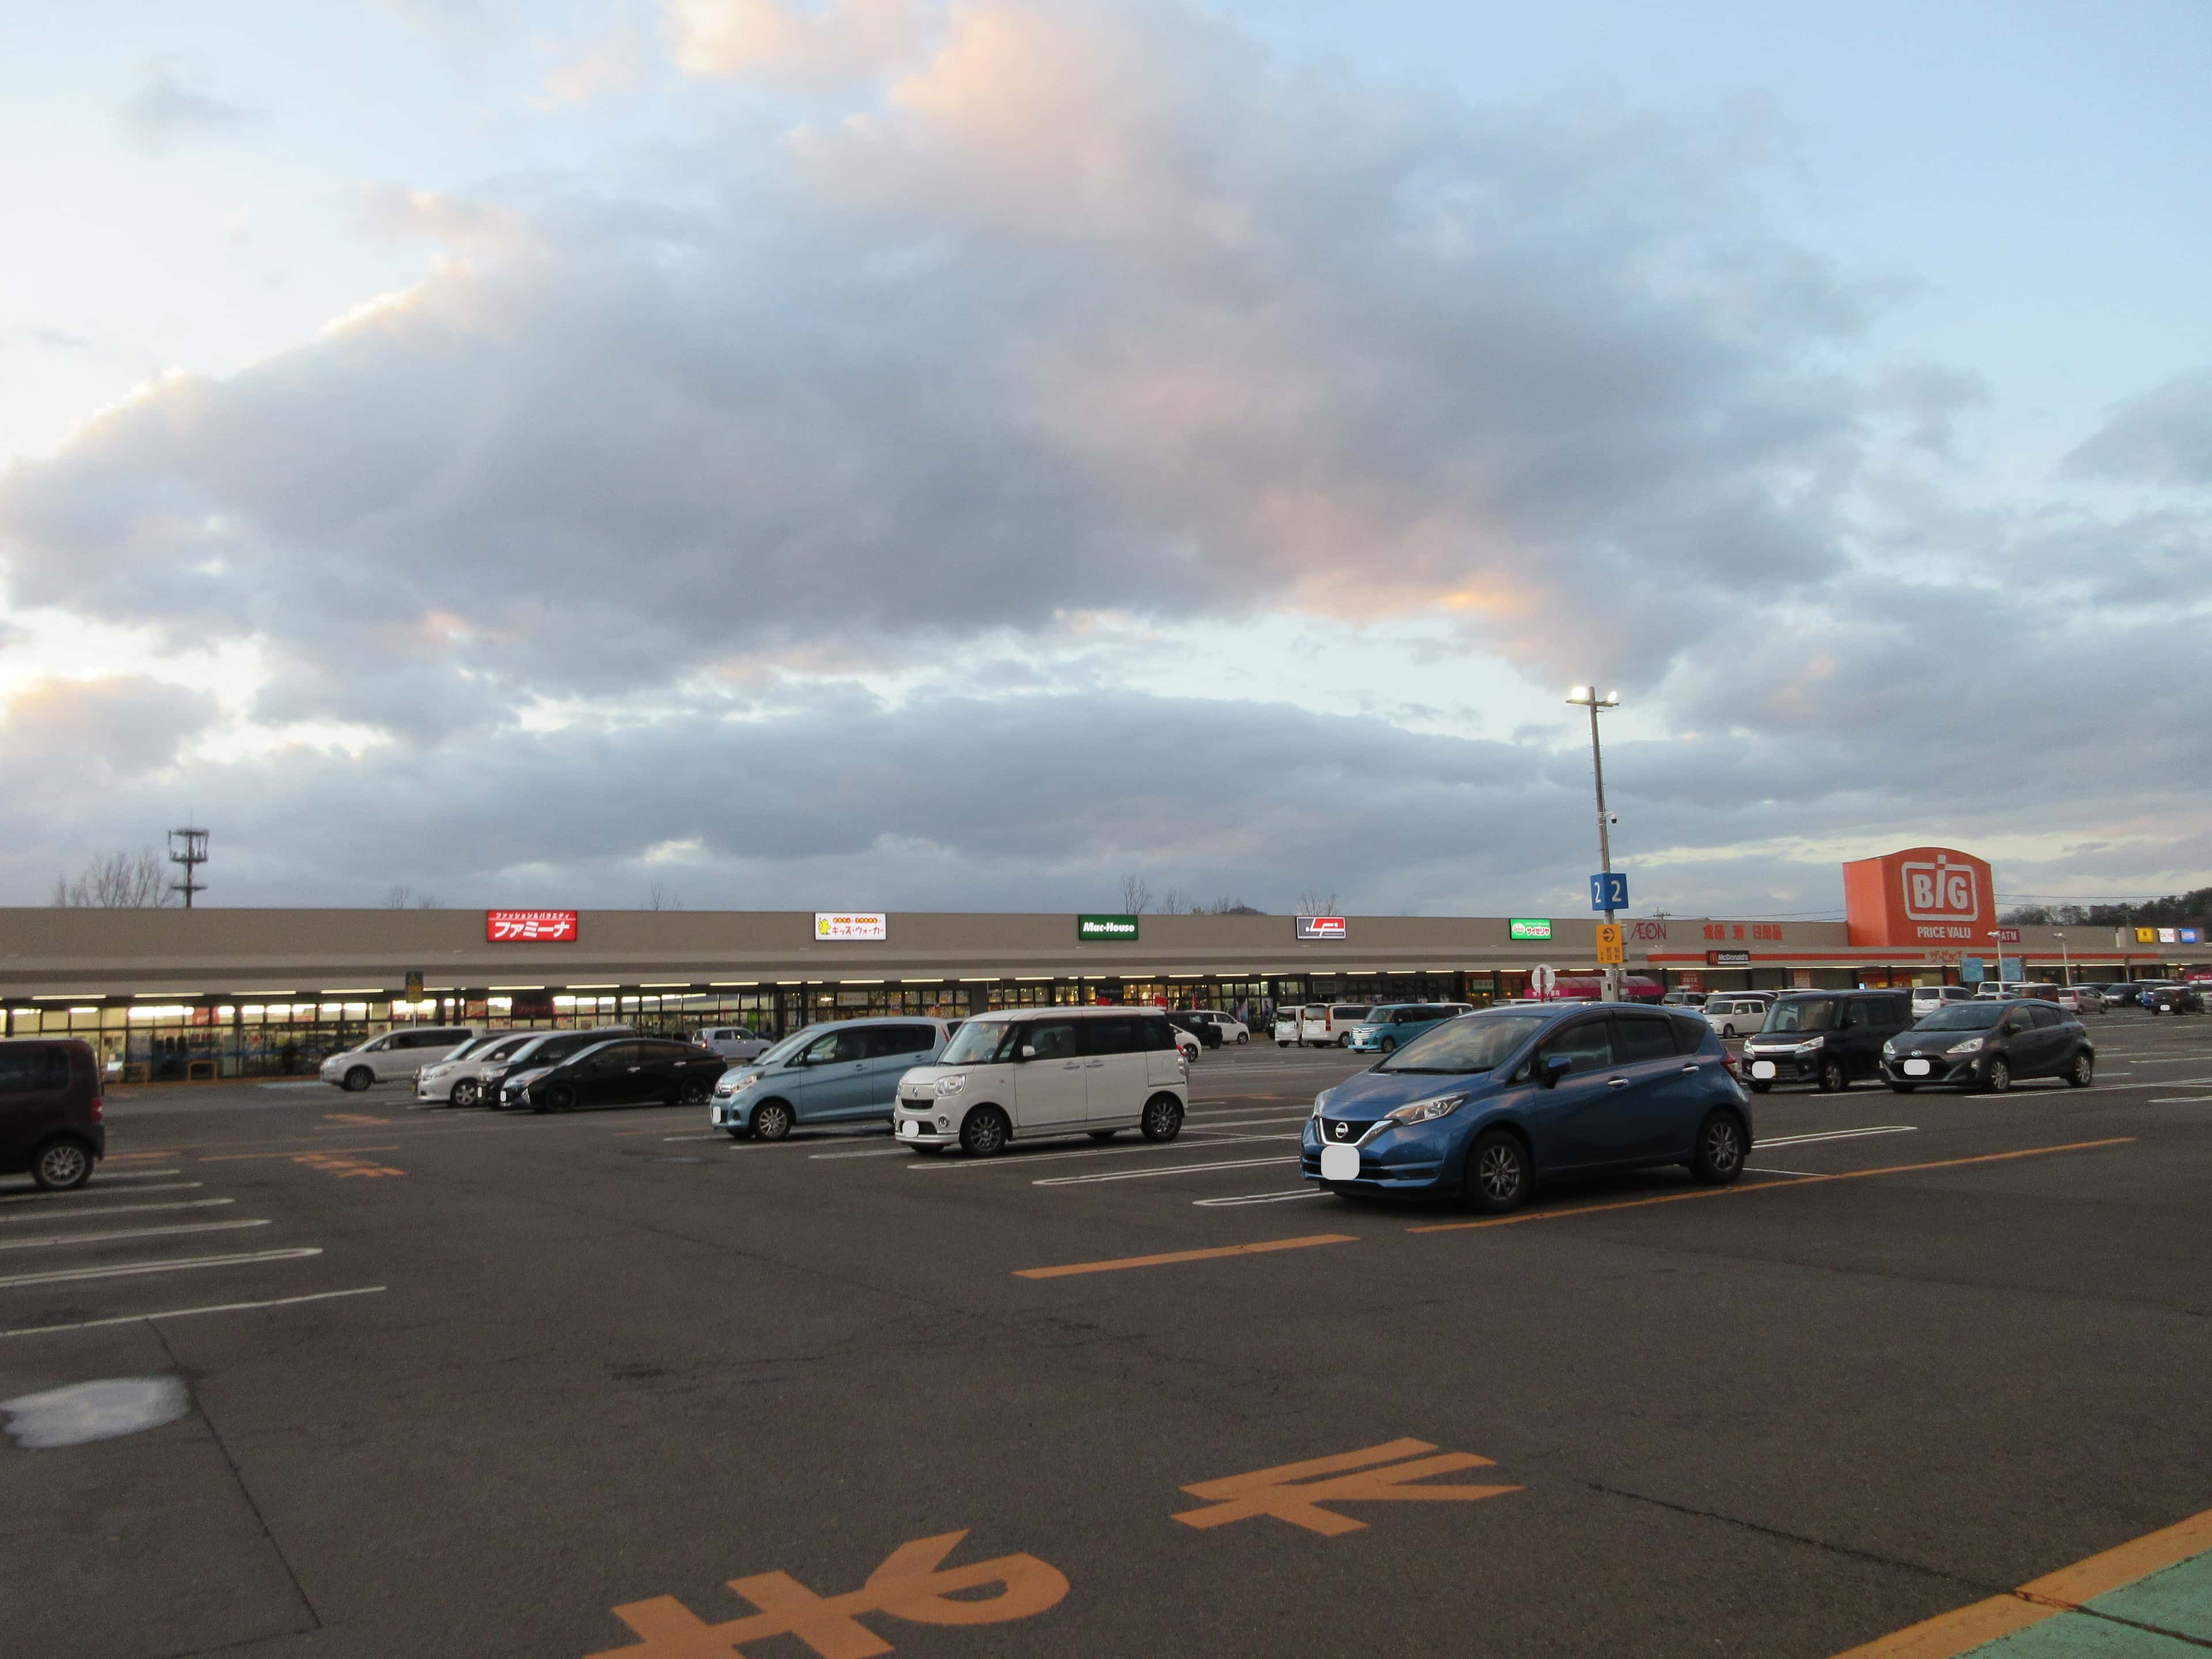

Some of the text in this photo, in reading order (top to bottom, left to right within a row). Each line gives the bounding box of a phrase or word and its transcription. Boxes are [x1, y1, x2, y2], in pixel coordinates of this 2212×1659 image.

[1594, 882, 1601, 903] 2
[1611, 880, 1622, 902] 2
[494, 921, 570, 938] ファミーナ
[1917, 926, 1972, 938] PRICE VALU
